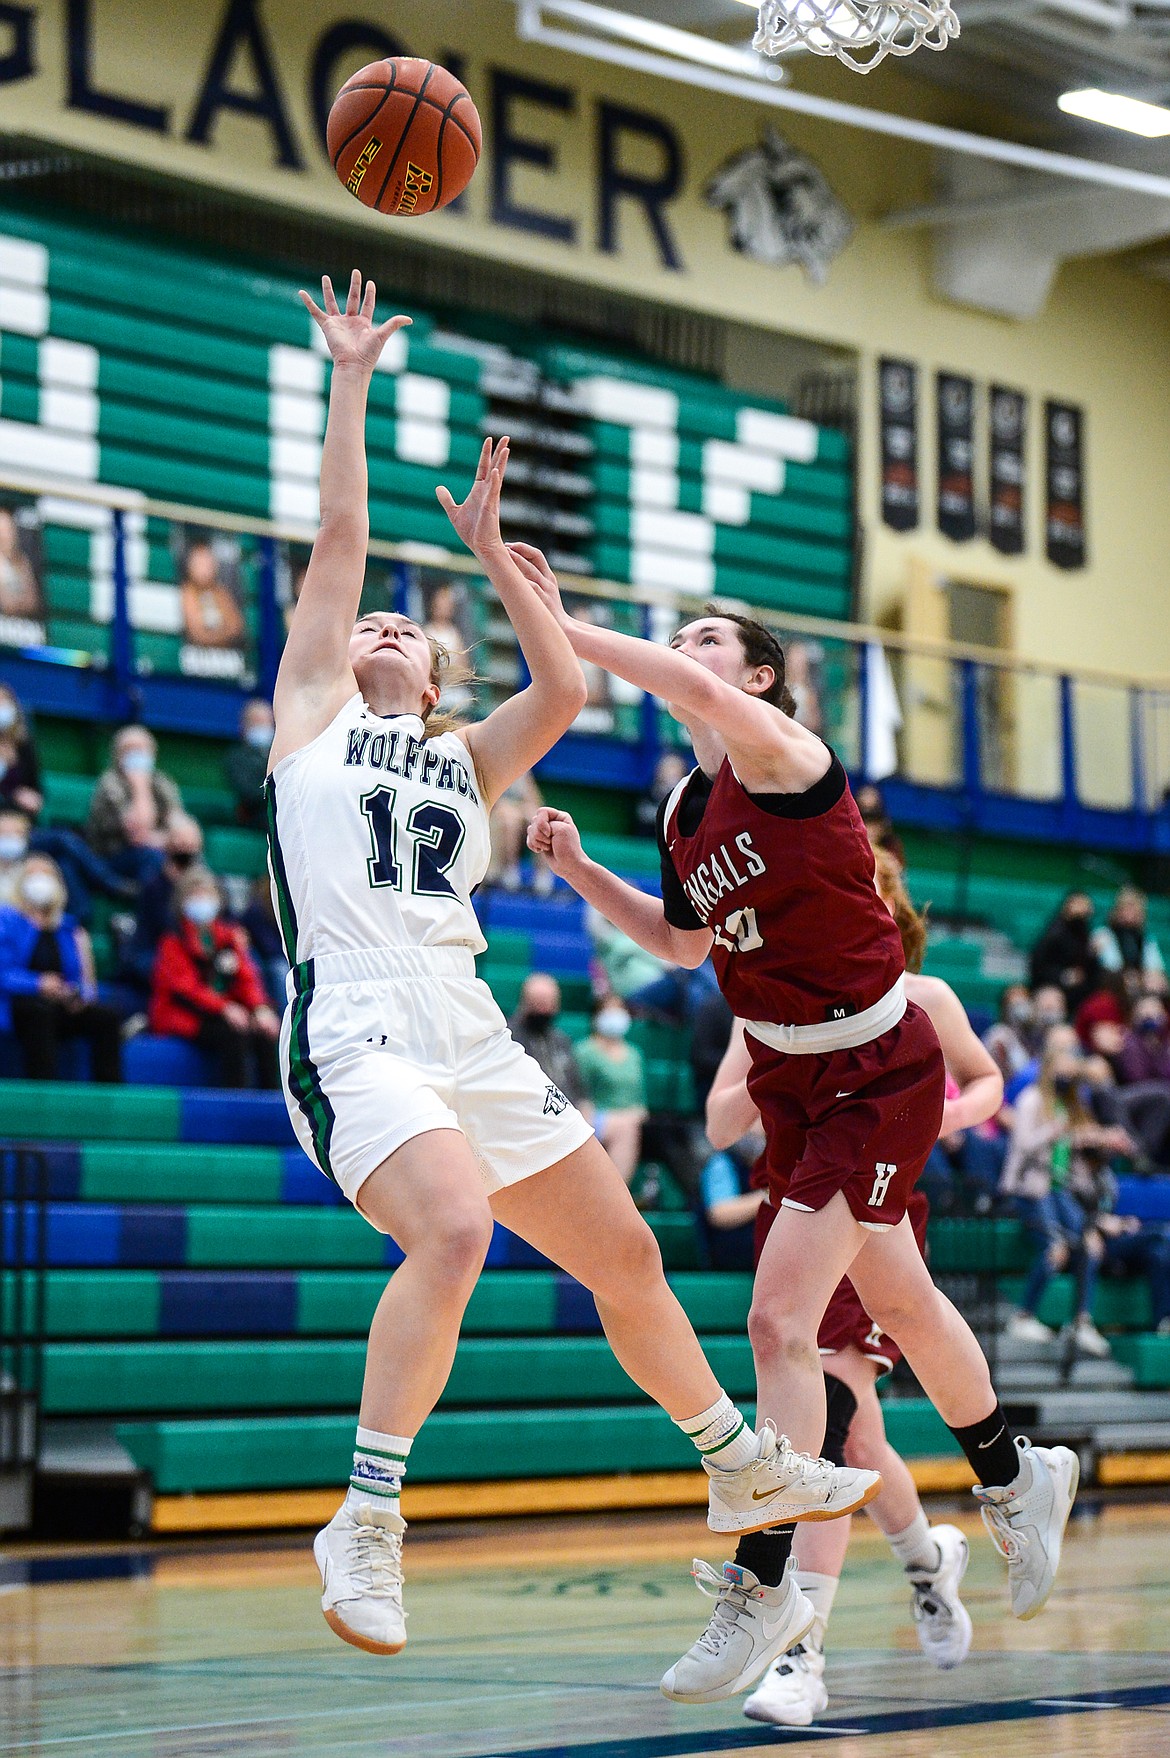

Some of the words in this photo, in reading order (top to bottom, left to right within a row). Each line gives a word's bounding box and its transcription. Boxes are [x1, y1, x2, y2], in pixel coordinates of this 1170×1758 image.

[345, 135, 384, 198] ELITE
[360, 783, 467, 906] 12
[833, 1008, 846, 1019] M
[867, 1162, 898, 1207] H
